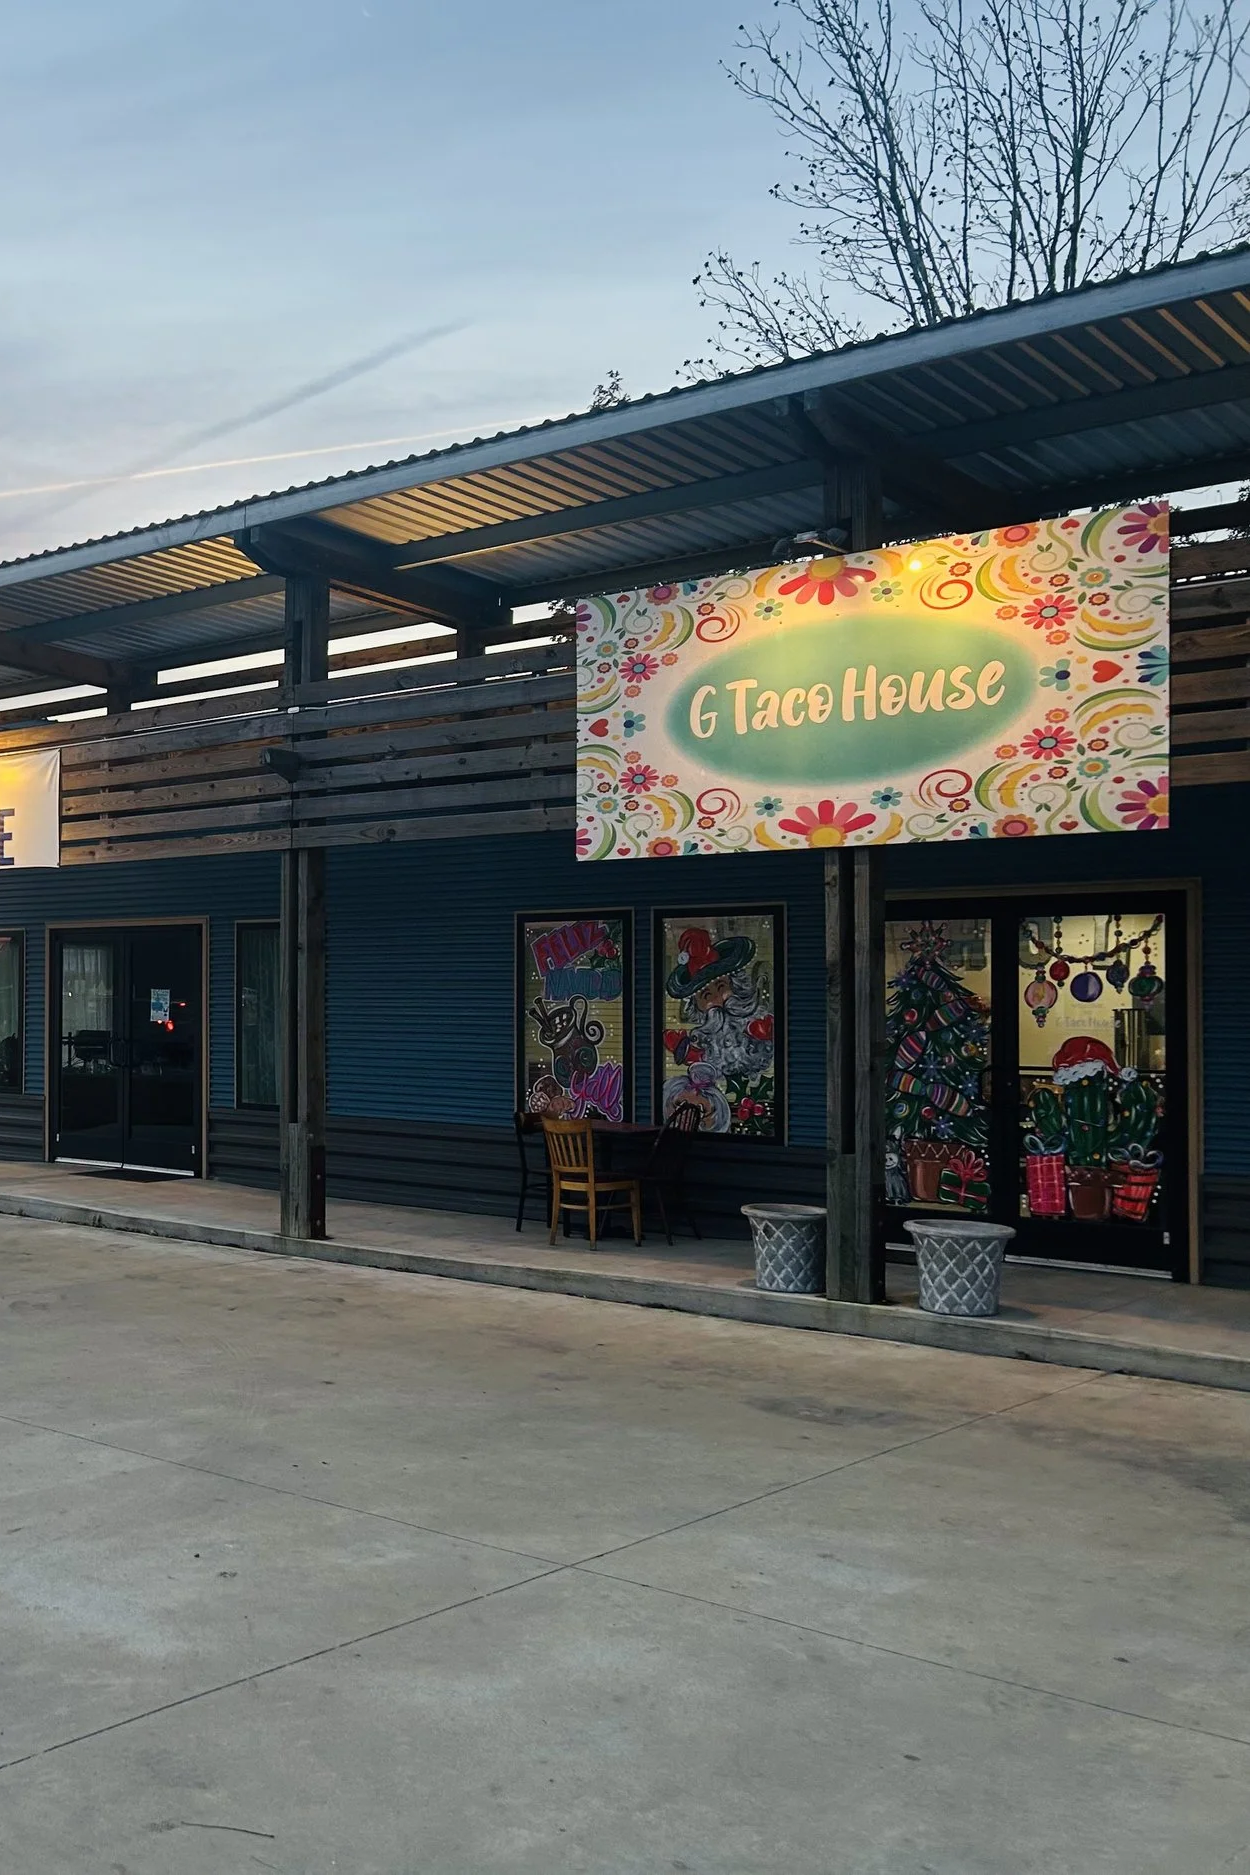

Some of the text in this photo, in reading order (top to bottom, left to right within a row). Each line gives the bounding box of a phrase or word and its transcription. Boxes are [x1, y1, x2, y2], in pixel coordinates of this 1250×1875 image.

[689, 660, 1006, 739] G Taco House
[530, 921, 609, 978] FELIZ
